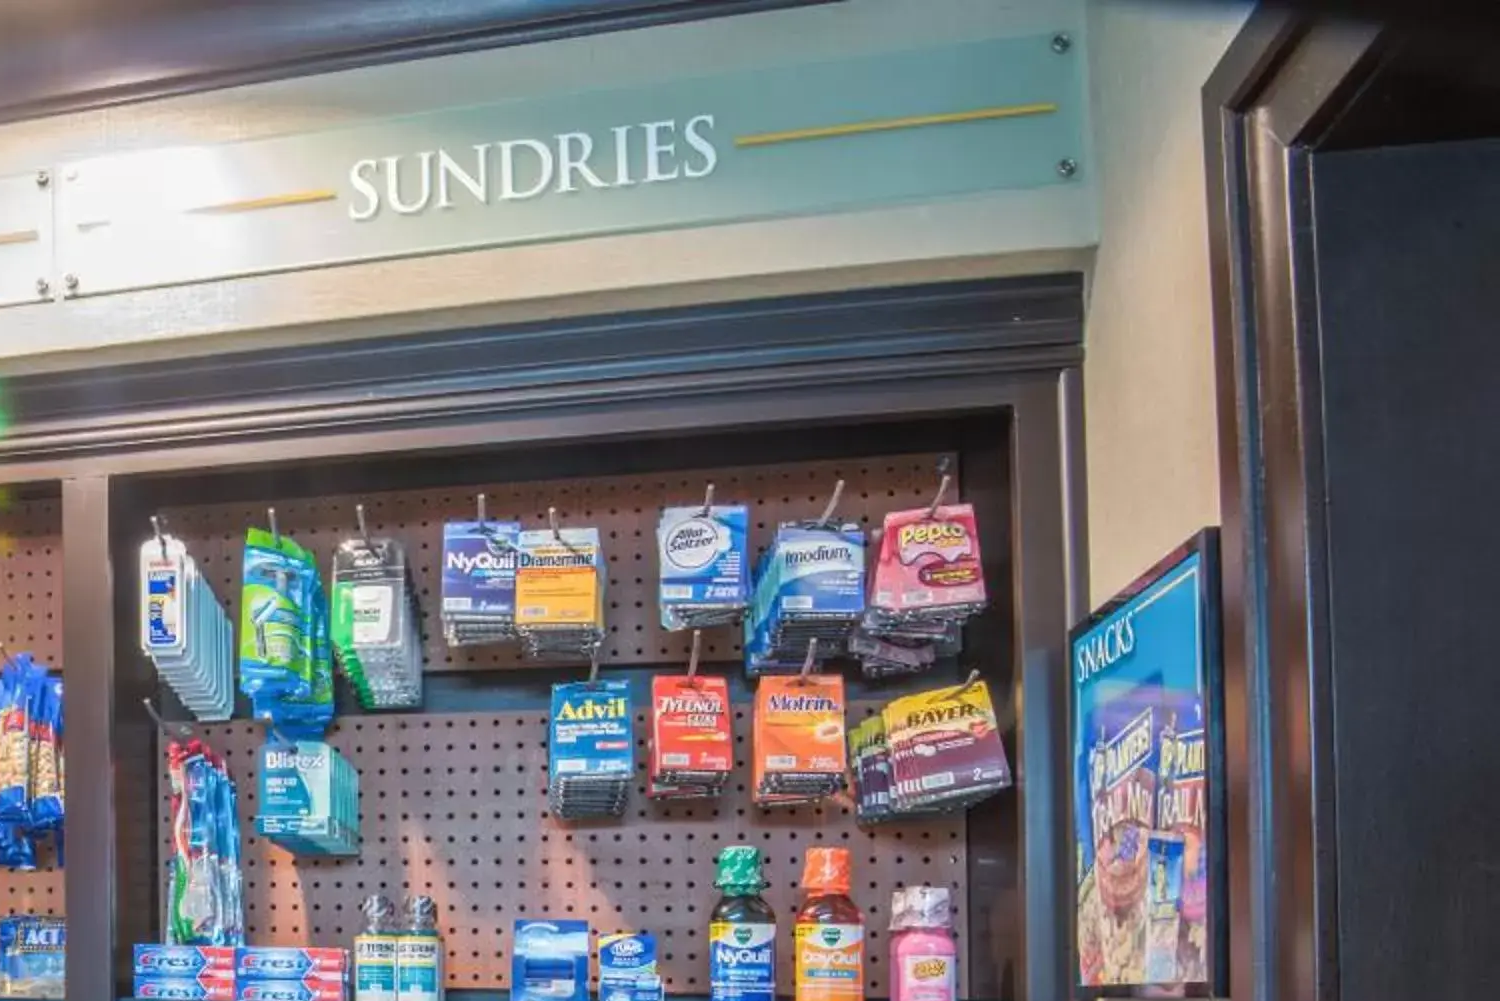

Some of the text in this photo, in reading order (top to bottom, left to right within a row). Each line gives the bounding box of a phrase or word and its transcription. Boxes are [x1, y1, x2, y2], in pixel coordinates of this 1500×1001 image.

[347, 114, 718, 222] SUNDRIES
[447, 552, 515, 574] NyQuil
[1077, 610, 1135, 683] SNACKS
[556, 698, 627, 720] Advil
[907, 703, 975, 728] BAYER
